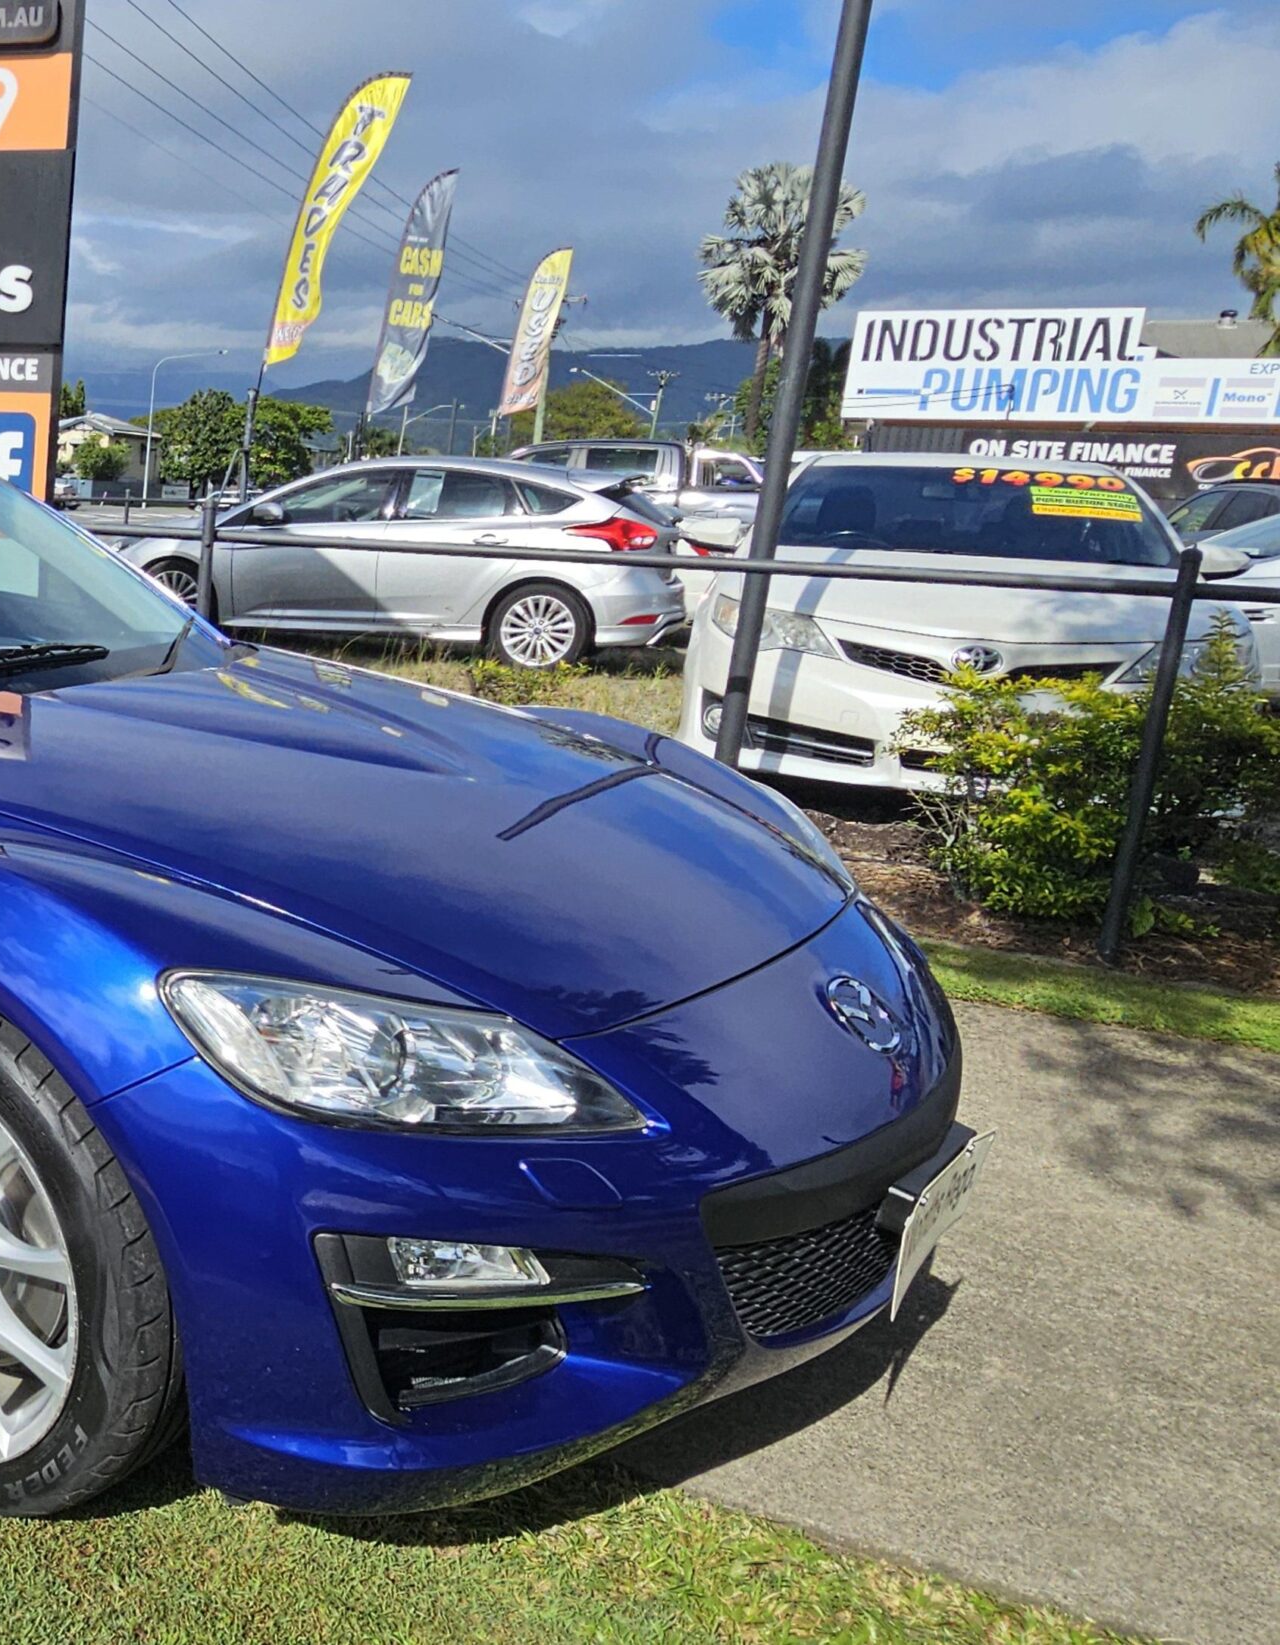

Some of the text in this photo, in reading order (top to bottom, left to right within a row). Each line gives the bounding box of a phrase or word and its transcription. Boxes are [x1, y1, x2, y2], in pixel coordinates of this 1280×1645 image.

[292, 104, 385, 310] TRADES
[918, 368, 1140, 413] PUMPING
[1222, 392, 1266, 403] Mono
[969, 438, 1177, 464] ON SITE FINANCE
[953, 467, 1126, 491] $14990
[1124, 467, 1172, 478] FINANCE
